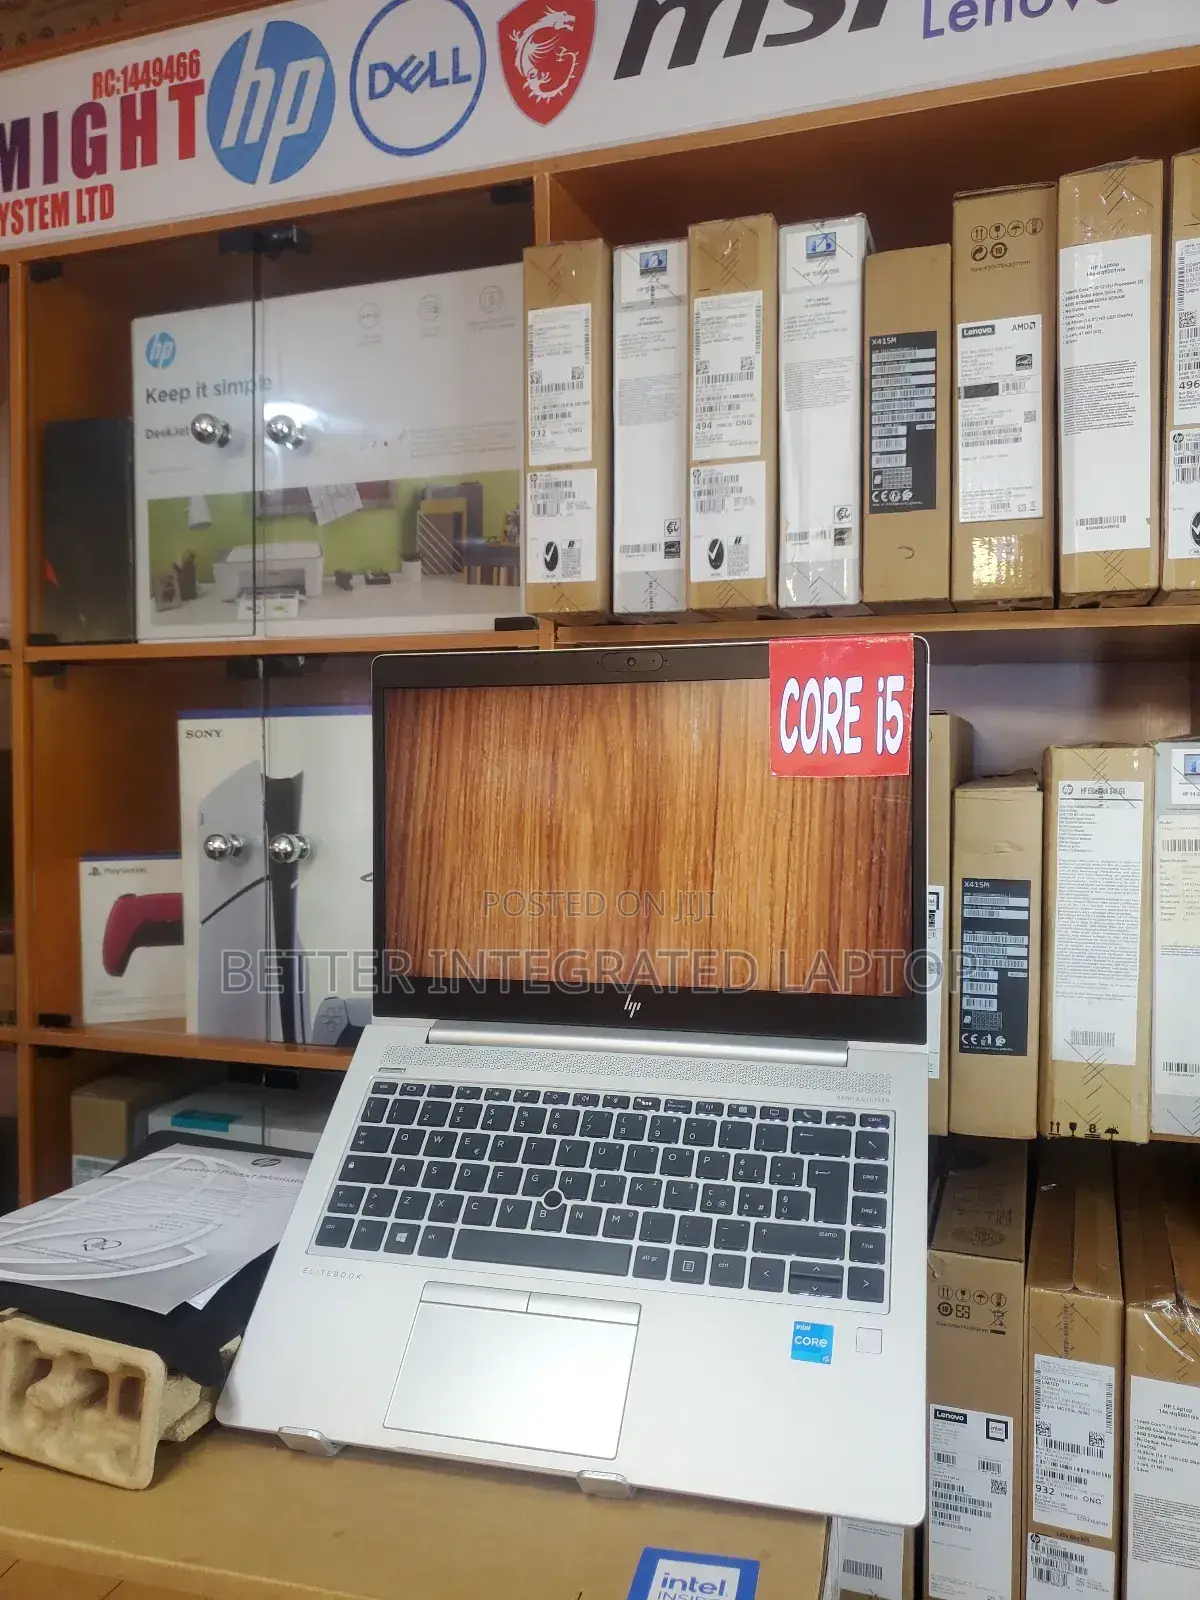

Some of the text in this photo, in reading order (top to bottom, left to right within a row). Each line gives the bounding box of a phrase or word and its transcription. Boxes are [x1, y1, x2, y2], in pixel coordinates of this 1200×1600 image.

[92, 48, 200, 100] RC:1449466
[368, 46, 472, 101] DELL
[220, 21, 327, 185] hp
[0, 79, 205, 193] MIGHT
[76, 183, 115, 225] LTD
[963, 322, 1030, 336] Lenovo AMD
[872, 337, 897, 346] X415M
[146, 374, 273, 404] Keep it simple
[1178, 380, 1200, 390] 496
[695, 421, 712, 430] 494
[735, 419, 752, 427] ONG
[531, 429, 546, 438] 932
[779, 675, 905, 755] CORE i5
[185, 729, 224, 739] SONY
[963, 881, 990, 889] X415M
[519, 1120, 526, 1128] 5
[434, 1135, 443, 1143] W
[464, 1137, 471, 1145] E
[497, 1140, 505, 1148] R
[530, 1142, 537, 1150] T
[565, 1144, 571, 1152] Y
[703, 1156, 711, 1164] P
[398, 1164, 406, 1172] A
[431, 1166, 438, 1174] S
[463, 1169, 471, 1177] D
[496, 1171, 504, 1179] F
[531, 1174, 539, 1182] G
[565, 1177, 573, 1185] H
[635, 1183, 643, 1191] K
[404, 1196, 412, 1205] Z
[437, 1199, 445, 1208] X
[471, 1202, 479, 1210] C
[506, 1205, 513, 1213] V
[539, 1210, 547, 1218] B
[575, 1211, 584, 1220] N
[611, 1215, 621, 1223] M
[818, 1230, 838, 1238] stamp
[302, 1267, 363, 1280] ELITEBOOK
[796, 1323, 811, 1331] intel
[1172, 1405, 1193, 1414] Laptop
[936, 1410, 965, 1421] Lenovo
[1035, 1484, 1055, 1496] 932
[1082, 1495, 1102, 1506] ONG
[660, 1572, 727, 1597] intel
